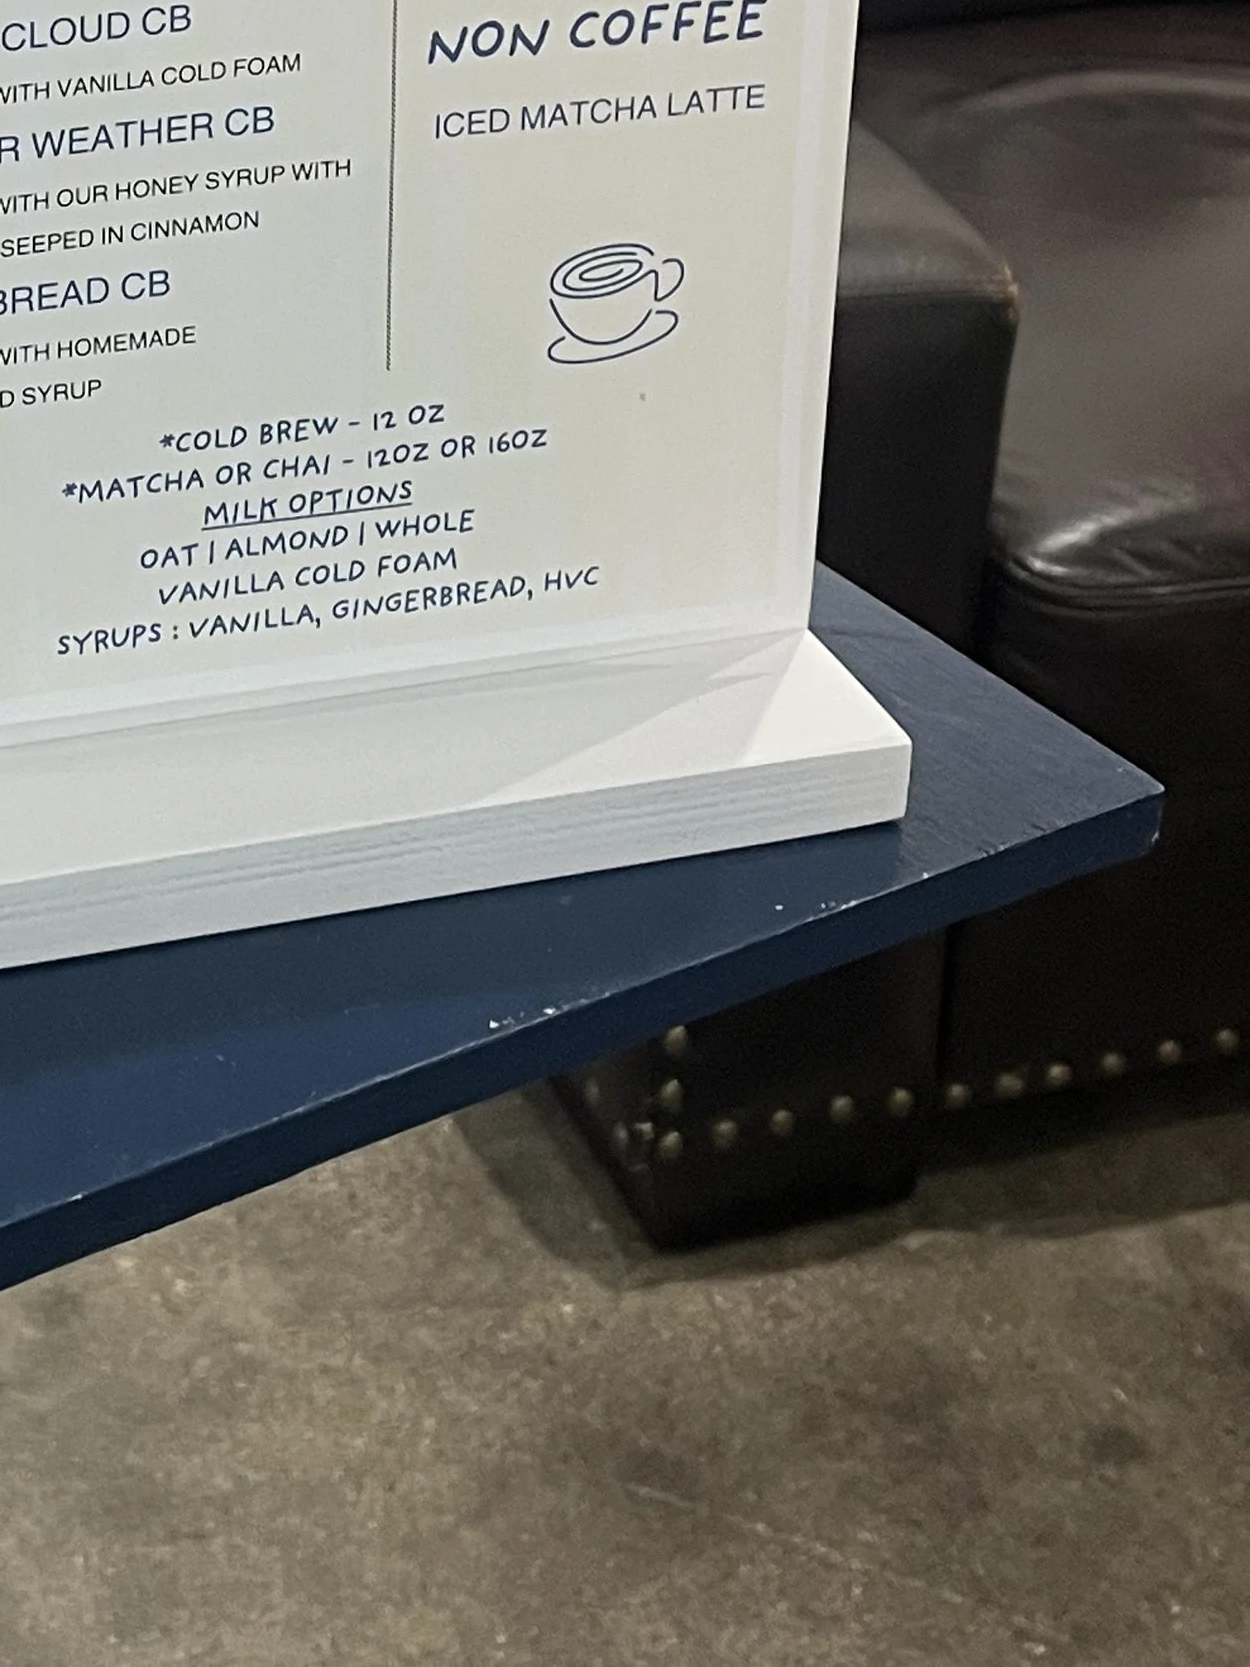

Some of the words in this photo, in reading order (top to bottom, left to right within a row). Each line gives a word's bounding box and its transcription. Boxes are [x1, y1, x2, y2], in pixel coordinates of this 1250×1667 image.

[1, 11, 131, 52] CLOUD
[141, 4, 192, 36] CB
[427, 18, 551, 65] NON
[56, 69, 155, 98] VANILLA
[160, 60, 227, 86] COLD
[233, 52, 301, 78] FOAM
[31, 112, 214, 160] WEATHER
[224, 105, 275, 137] CB
[435, 107, 511, 140] ICED
[520, 94, 658, 131] MATCHA
[667, 83, 766, 117] LATTE
[56, 184, 109, 208] OUR
[115, 173, 200, 201] HONEY
[204, 164, 286, 191] SYRUP
[291, 158, 352, 182] WITH
[0, 228, 95, 259] SEEPED
[101, 224, 124, 246] IN
[130, 210, 260, 242] CINNAMON
[120, 269, 171, 301] CB
[57, 325, 197, 360] HOMEMADE
[21, 378, 103, 406] SYRUP
[259, 416, 339, 446] BREW
[373, 410, 397, 432] 12
[407, 403, 445, 426] OZ
[214, 461, 252, 486] OR
[262, 453, 331, 480] CHAI
[367, 442, 430, 470] 12OZ
[440, 434, 476, 460] OR
[488, 428, 548, 455] 16OZ
[202, 497, 278, 528] MILK
[288, 480, 413, 517] OPTIONS
[139, 542, 200, 570] OAT
[224, 524, 349, 561] ALMOND
[374, 508, 476, 539] WHOLE
[158, 570, 285, 606] VANILLA
[294, 559, 366, 587] COLD
[377, 547, 458, 578] FOAM
[188, 603, 322, 639] VANILLA,
[331, 575, 534, 620] GINGERBREAD,
[544, 565, 600, 592] HVC
